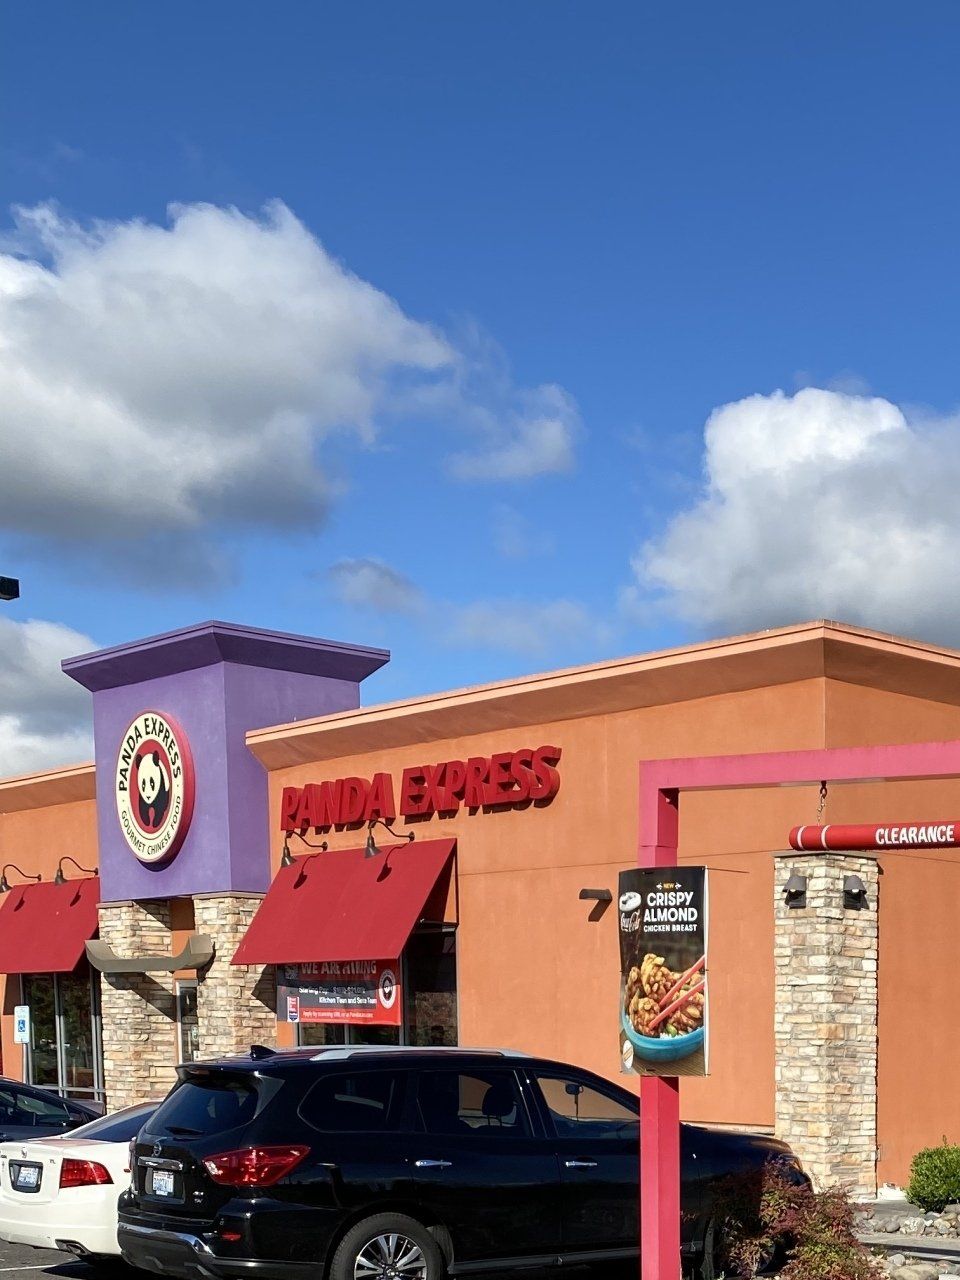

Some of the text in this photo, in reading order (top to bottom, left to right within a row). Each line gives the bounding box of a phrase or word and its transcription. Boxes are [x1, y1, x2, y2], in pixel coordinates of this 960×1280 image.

[119, 717, 181, 792] PANDA EXPRESS
[281, 745, 562, 831] PANDA EXPRESS
[121, 795, 181, 855] GOURMET CHINESE FOOD
[874, 824, 955, 845] CLEARANCE
[646, 891, 694, 907] CRISPY
[643, 907, 698, 923] ALMOND
[643, 924, 698, 932] CHICKEN BREAST
[301, 961, 319, 974] WE
